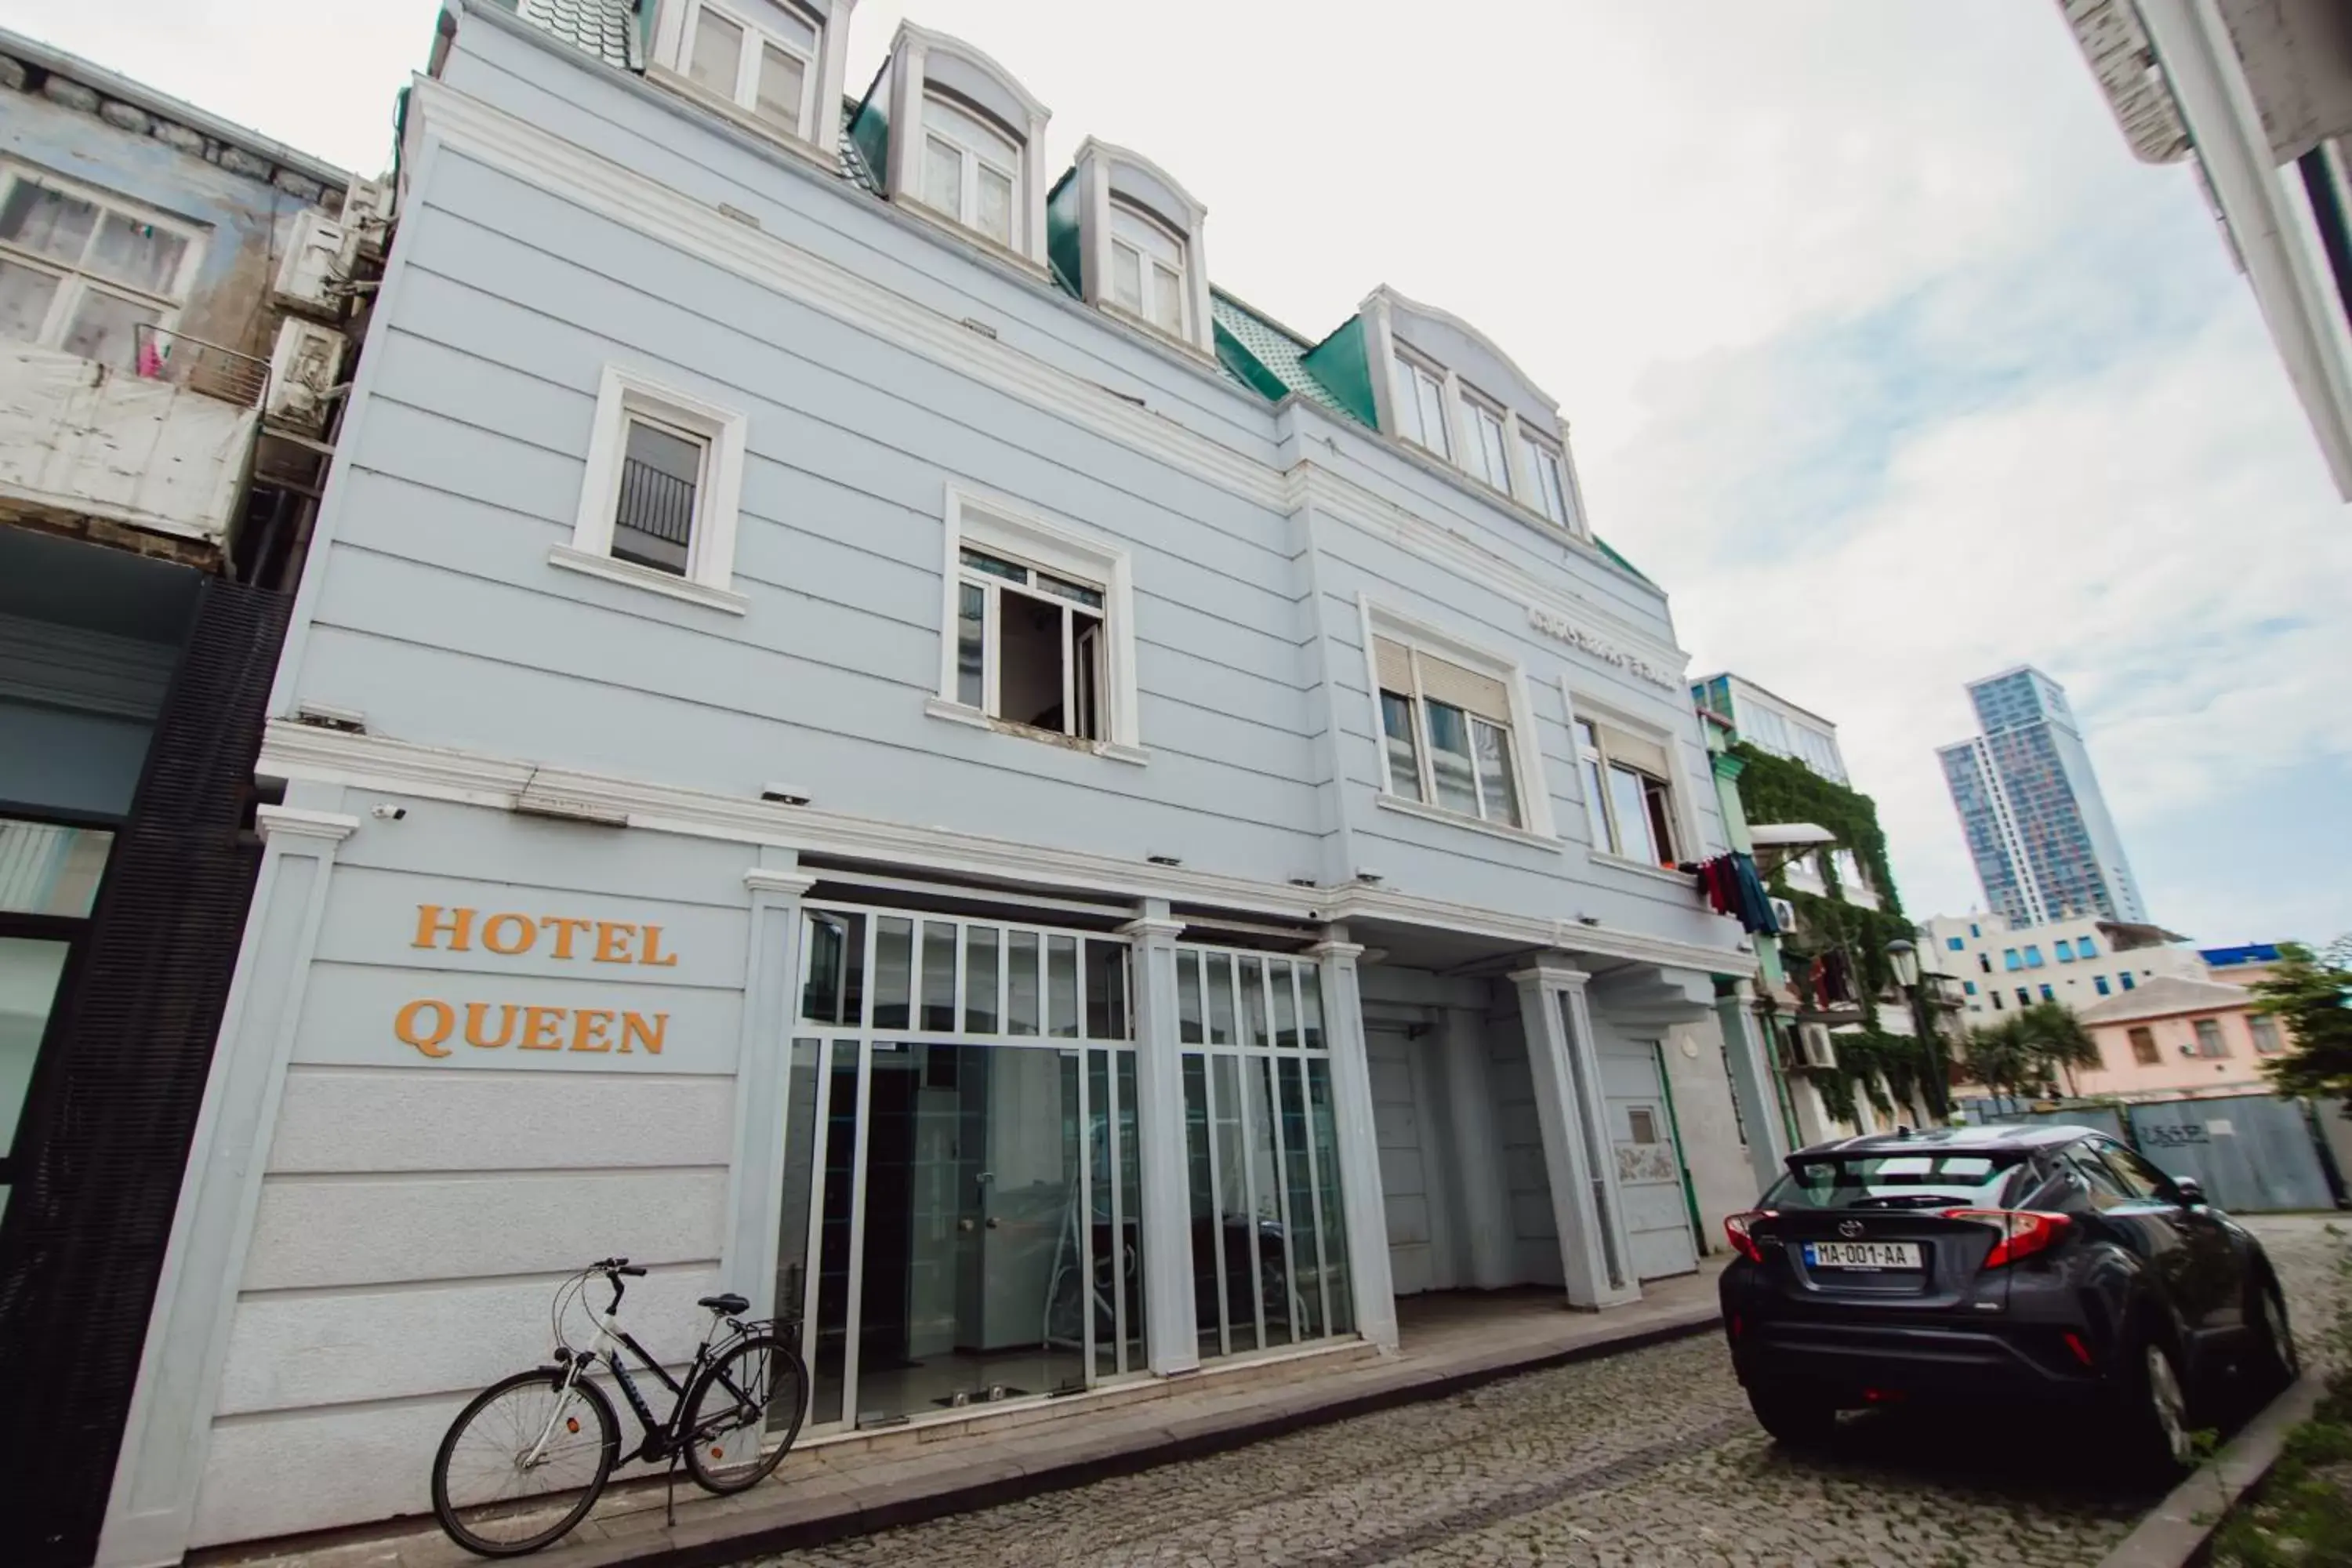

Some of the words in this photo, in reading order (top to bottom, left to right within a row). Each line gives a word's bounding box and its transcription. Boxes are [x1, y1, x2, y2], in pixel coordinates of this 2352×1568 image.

[410, 903, 678, 967] HOTEL
[394, 997, 670, 1058] QUEEN
[1817, 1243, 1907, 1265] MA-001-AA
